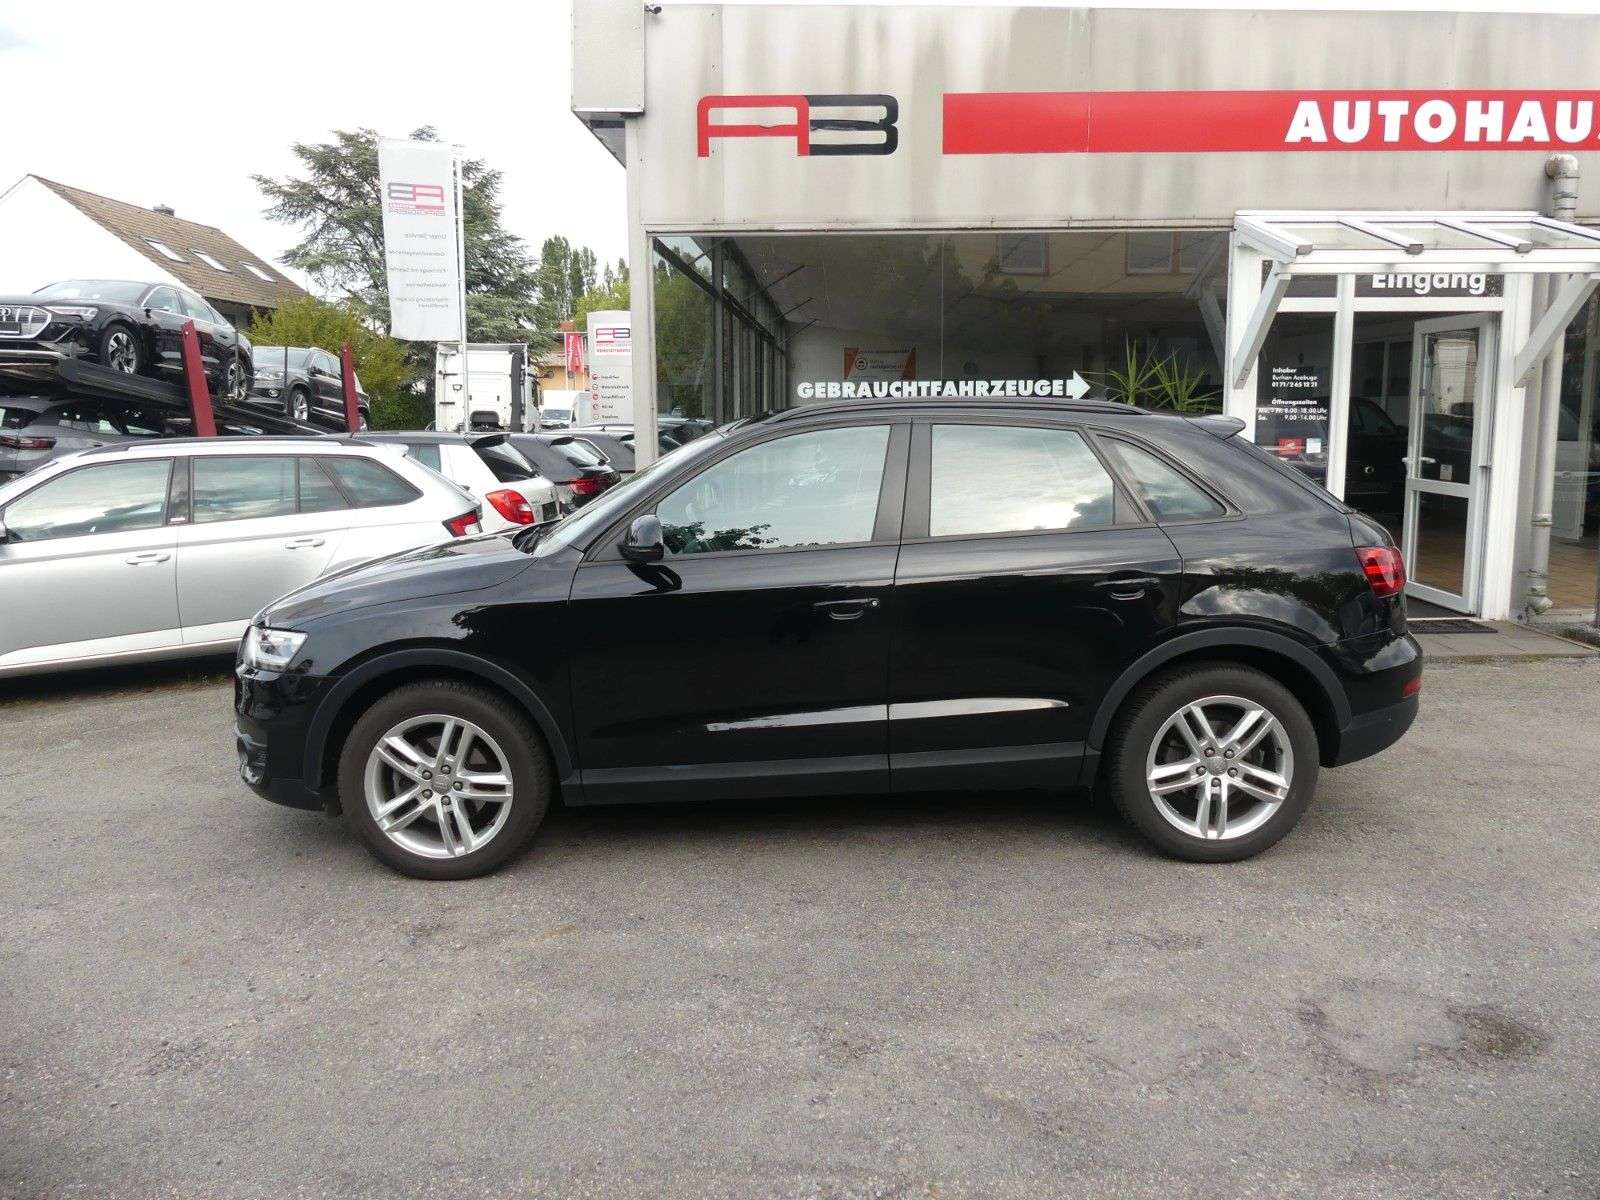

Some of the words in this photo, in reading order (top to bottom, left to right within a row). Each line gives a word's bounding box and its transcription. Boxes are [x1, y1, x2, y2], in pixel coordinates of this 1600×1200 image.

[697, 94, 898, 157] AB
[1284, 99, 1600, 144] AUTOHAU
[1372, 273, 1486, 295] Eingang
[797, 379, 1064, 399] GEBRAUCHTFAHRZEUGE
